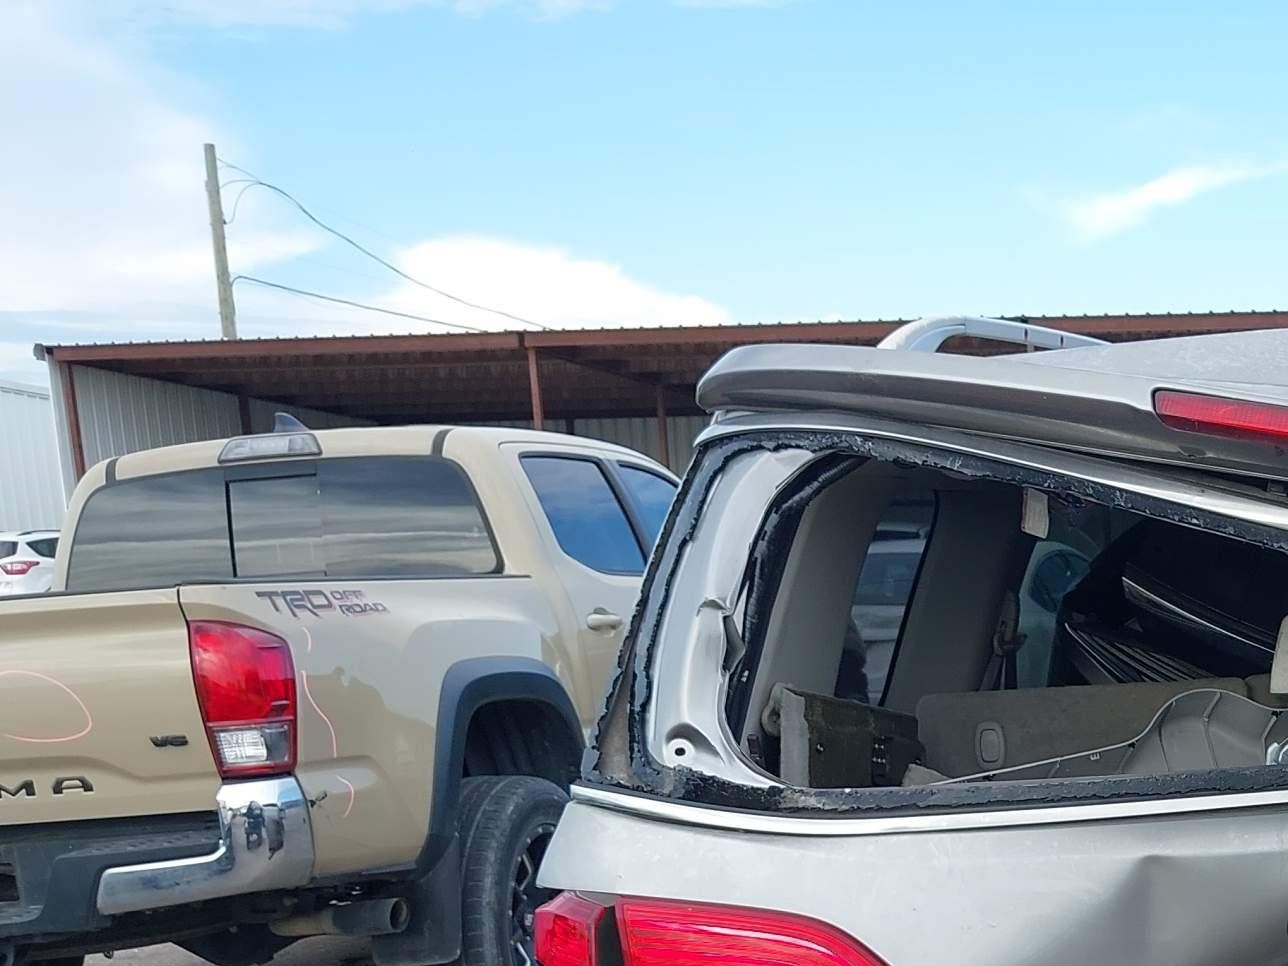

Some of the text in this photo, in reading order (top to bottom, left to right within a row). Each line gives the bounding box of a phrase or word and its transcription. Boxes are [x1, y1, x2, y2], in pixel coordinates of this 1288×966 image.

[255, 589, 366, 618] TRD OFF
[338, 602, 388, 616] ROAD
[150, 735, 189, 748] V6
